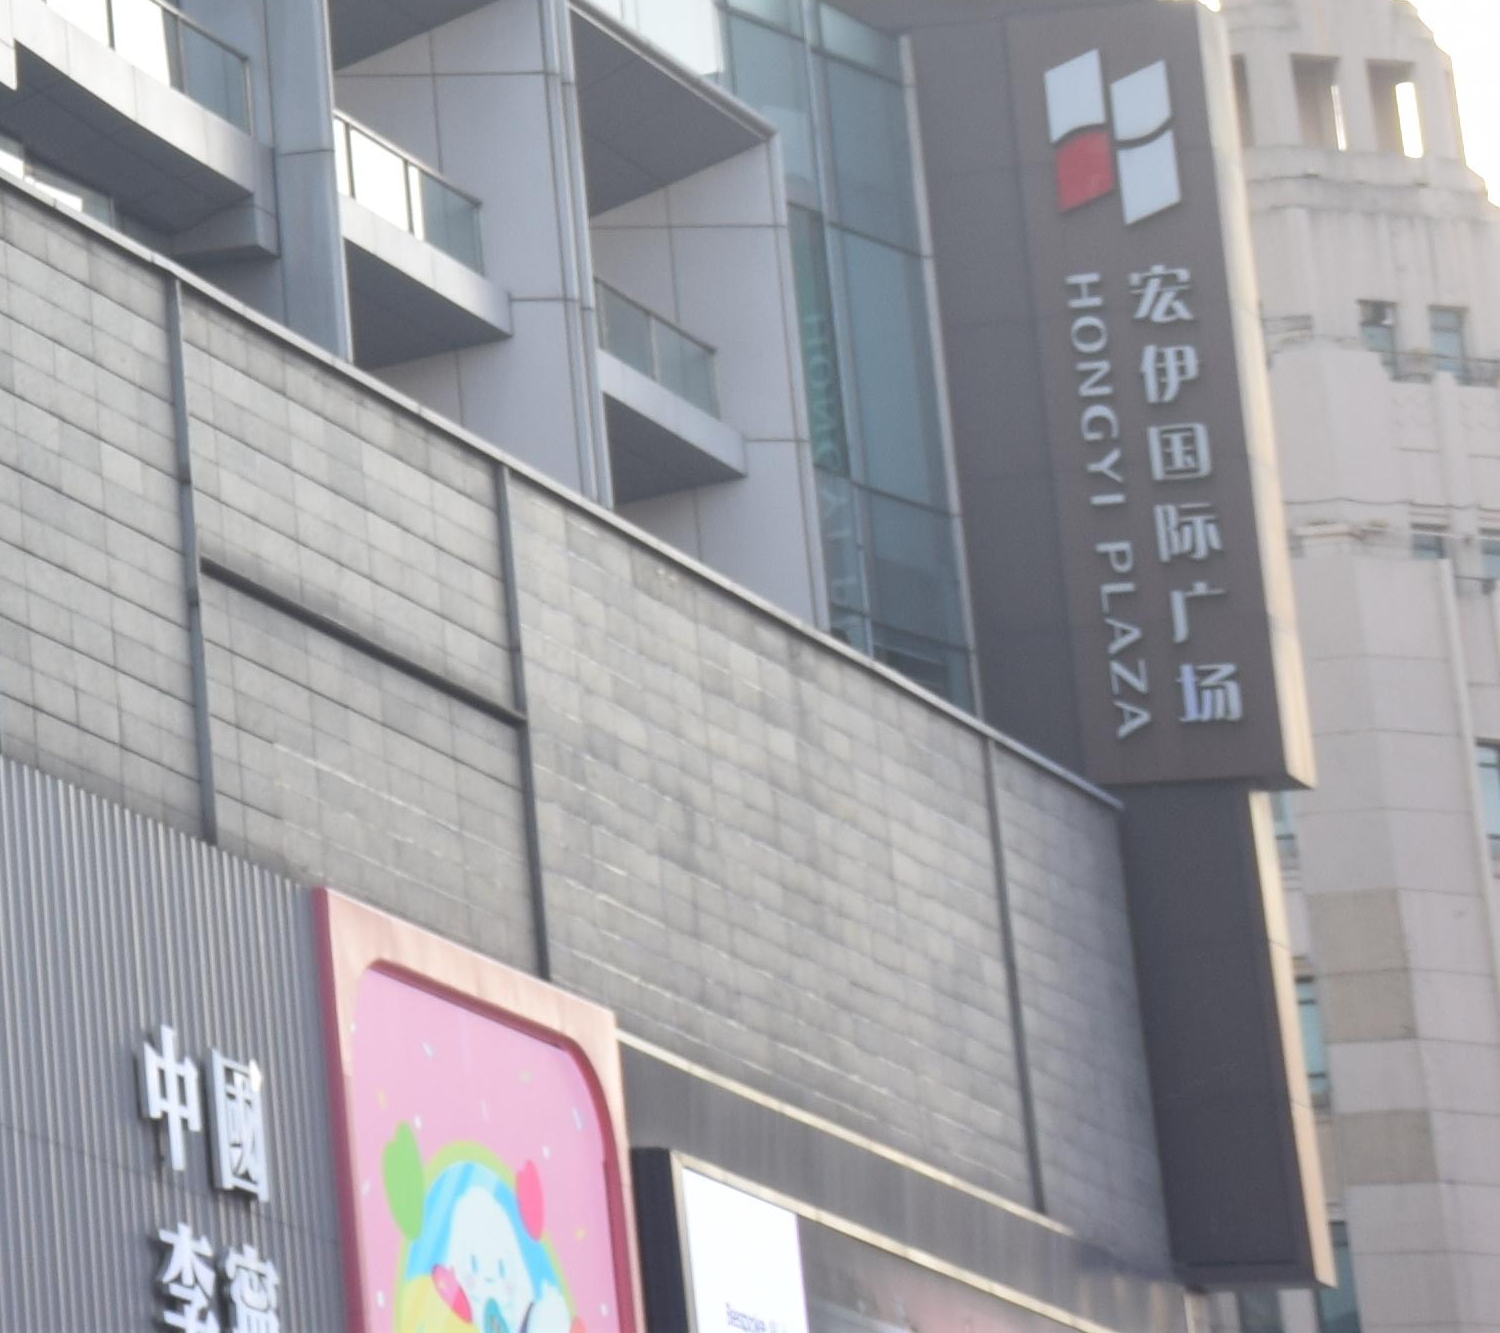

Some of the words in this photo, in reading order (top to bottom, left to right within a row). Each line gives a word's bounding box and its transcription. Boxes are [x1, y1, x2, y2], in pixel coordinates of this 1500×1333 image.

[1065, 271, 1126, 507] HONGYI
[1127, 264, 1244, 725] 宏伊国际广场
[1095, 540, 1153, 739] PLAZA
[140, 1024, 270, 1203] 中國
